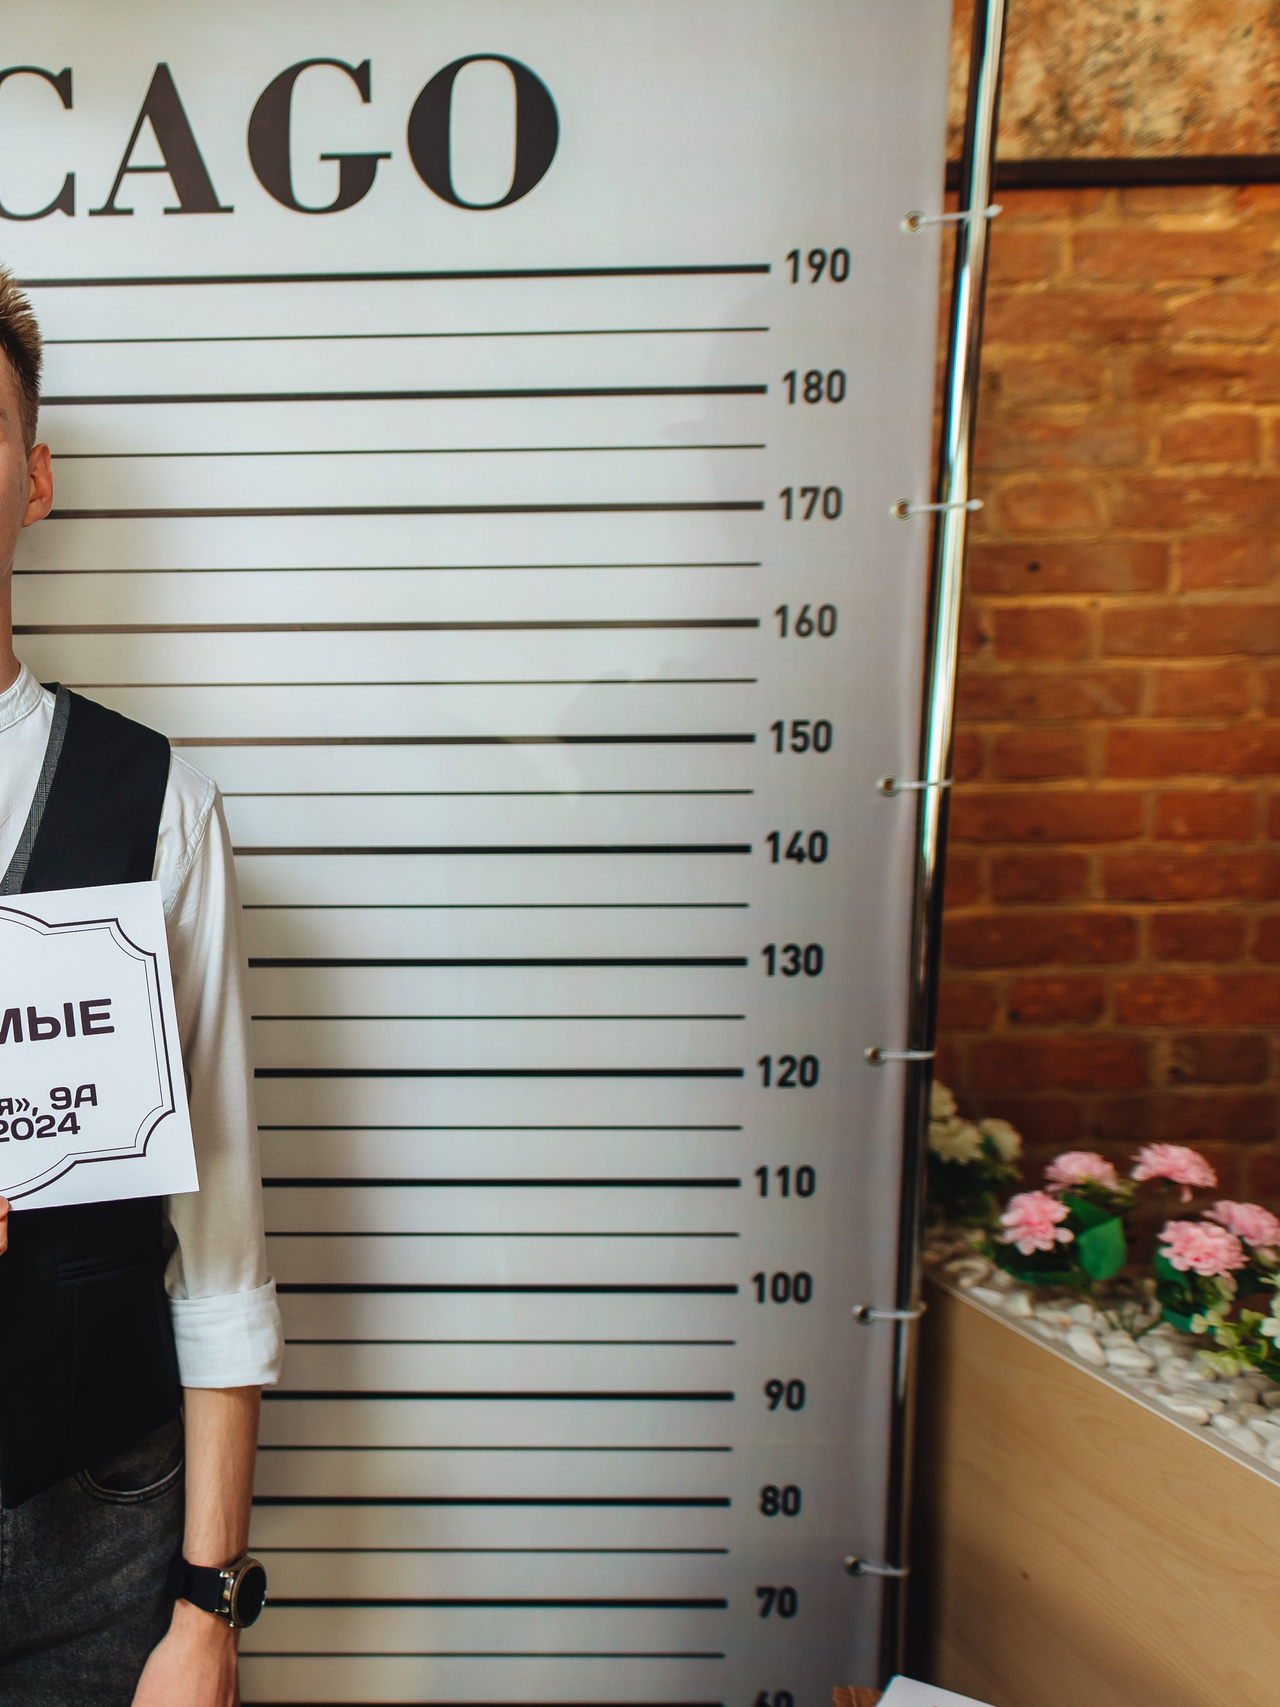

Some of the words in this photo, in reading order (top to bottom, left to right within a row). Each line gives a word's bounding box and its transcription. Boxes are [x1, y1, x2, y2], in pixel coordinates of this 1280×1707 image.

[786, 247, 851, 284] 190
[783, 369, 847, 405] 180
[779, 485, 843, 521] 170
[775, 603, 838, 639] 160
[770, 719, 833, 754] 150
[766, 829, 829, 865] 140
[761, 942, 824, 978] 130
[758, 1054, 820, 1089] 120
[49, 1083, 99, 1109] 9А
[754, 1164, 816, 1199] 110
[752, 1271, 813, 1305] 100
[764, 1378, 806, 1412] 90
[759, 1484, 802, 1518] 80
[756, 1585, 799, 1620] 70
